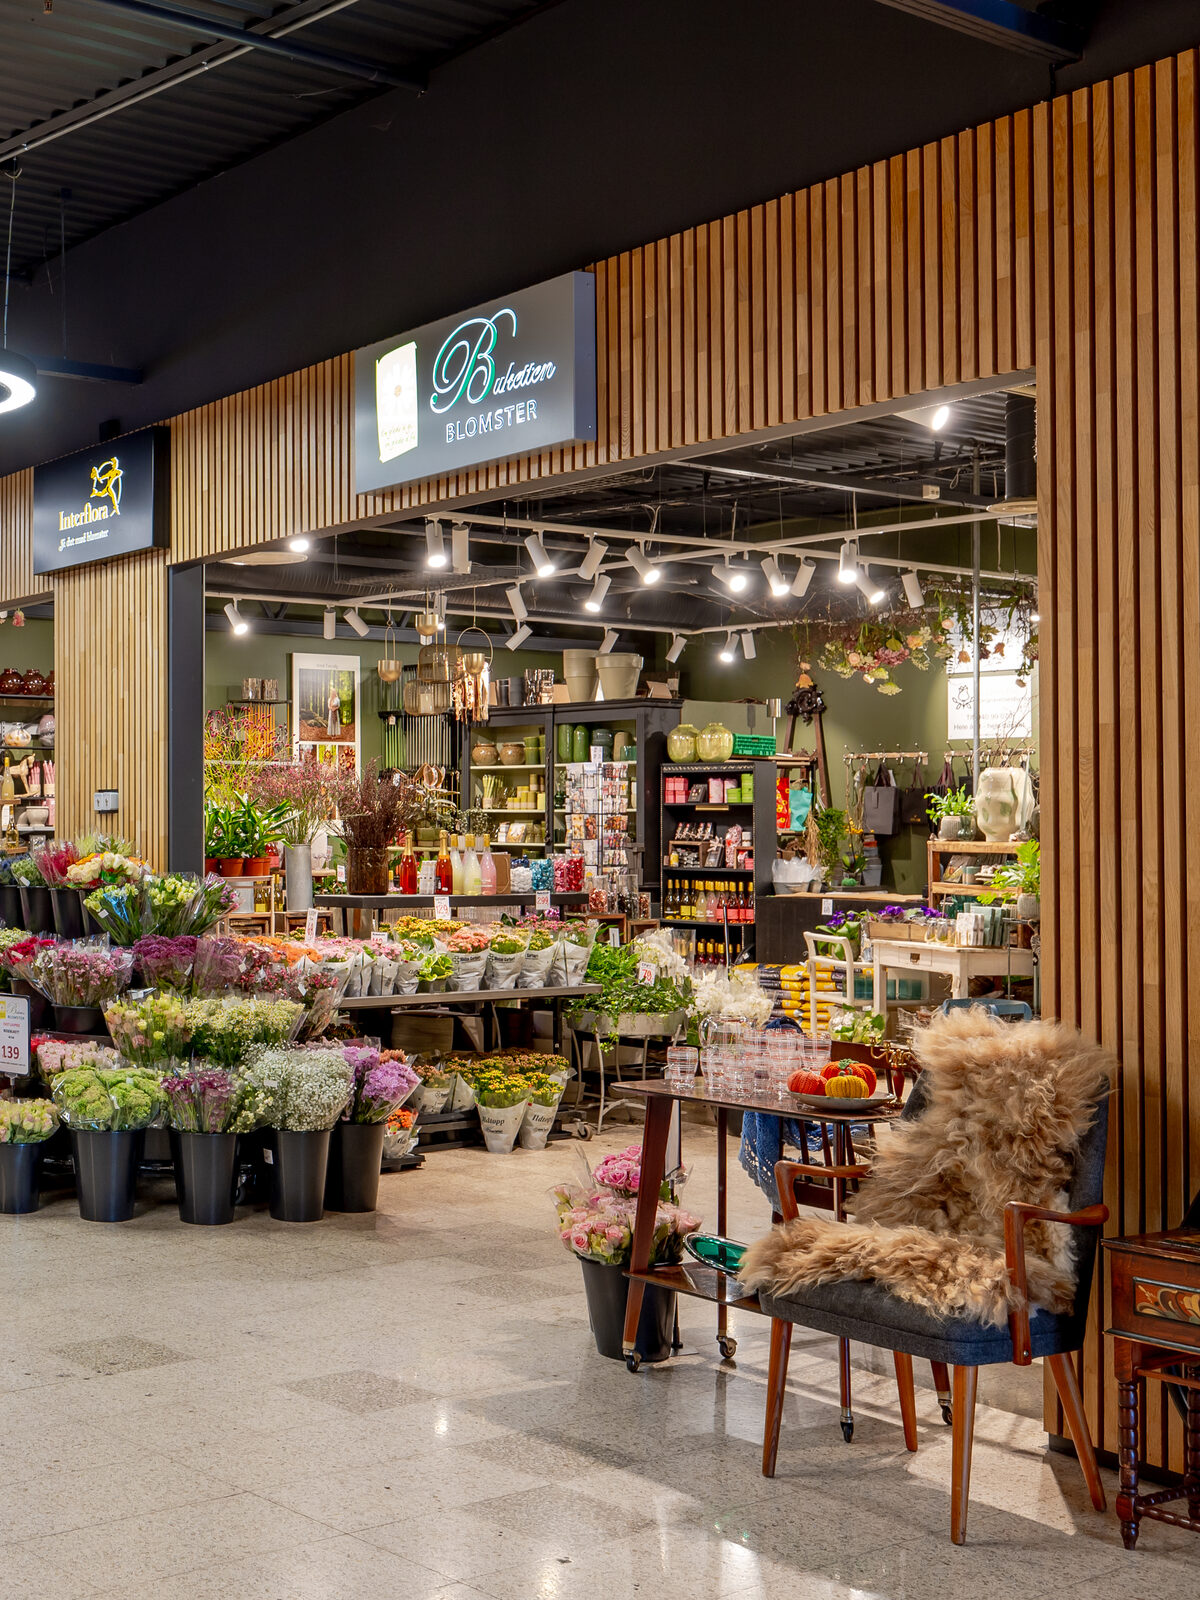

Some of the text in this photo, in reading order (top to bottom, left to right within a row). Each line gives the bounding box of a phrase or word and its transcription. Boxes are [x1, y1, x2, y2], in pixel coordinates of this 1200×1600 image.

[445, 399, 538, 444] BLOMSTER
[58, 502, 109, 531] Interflora
[75, 532, 87, 545] med
[87, 529, 110, 542] blomster
[1, 1045, 20, 1060] 139
